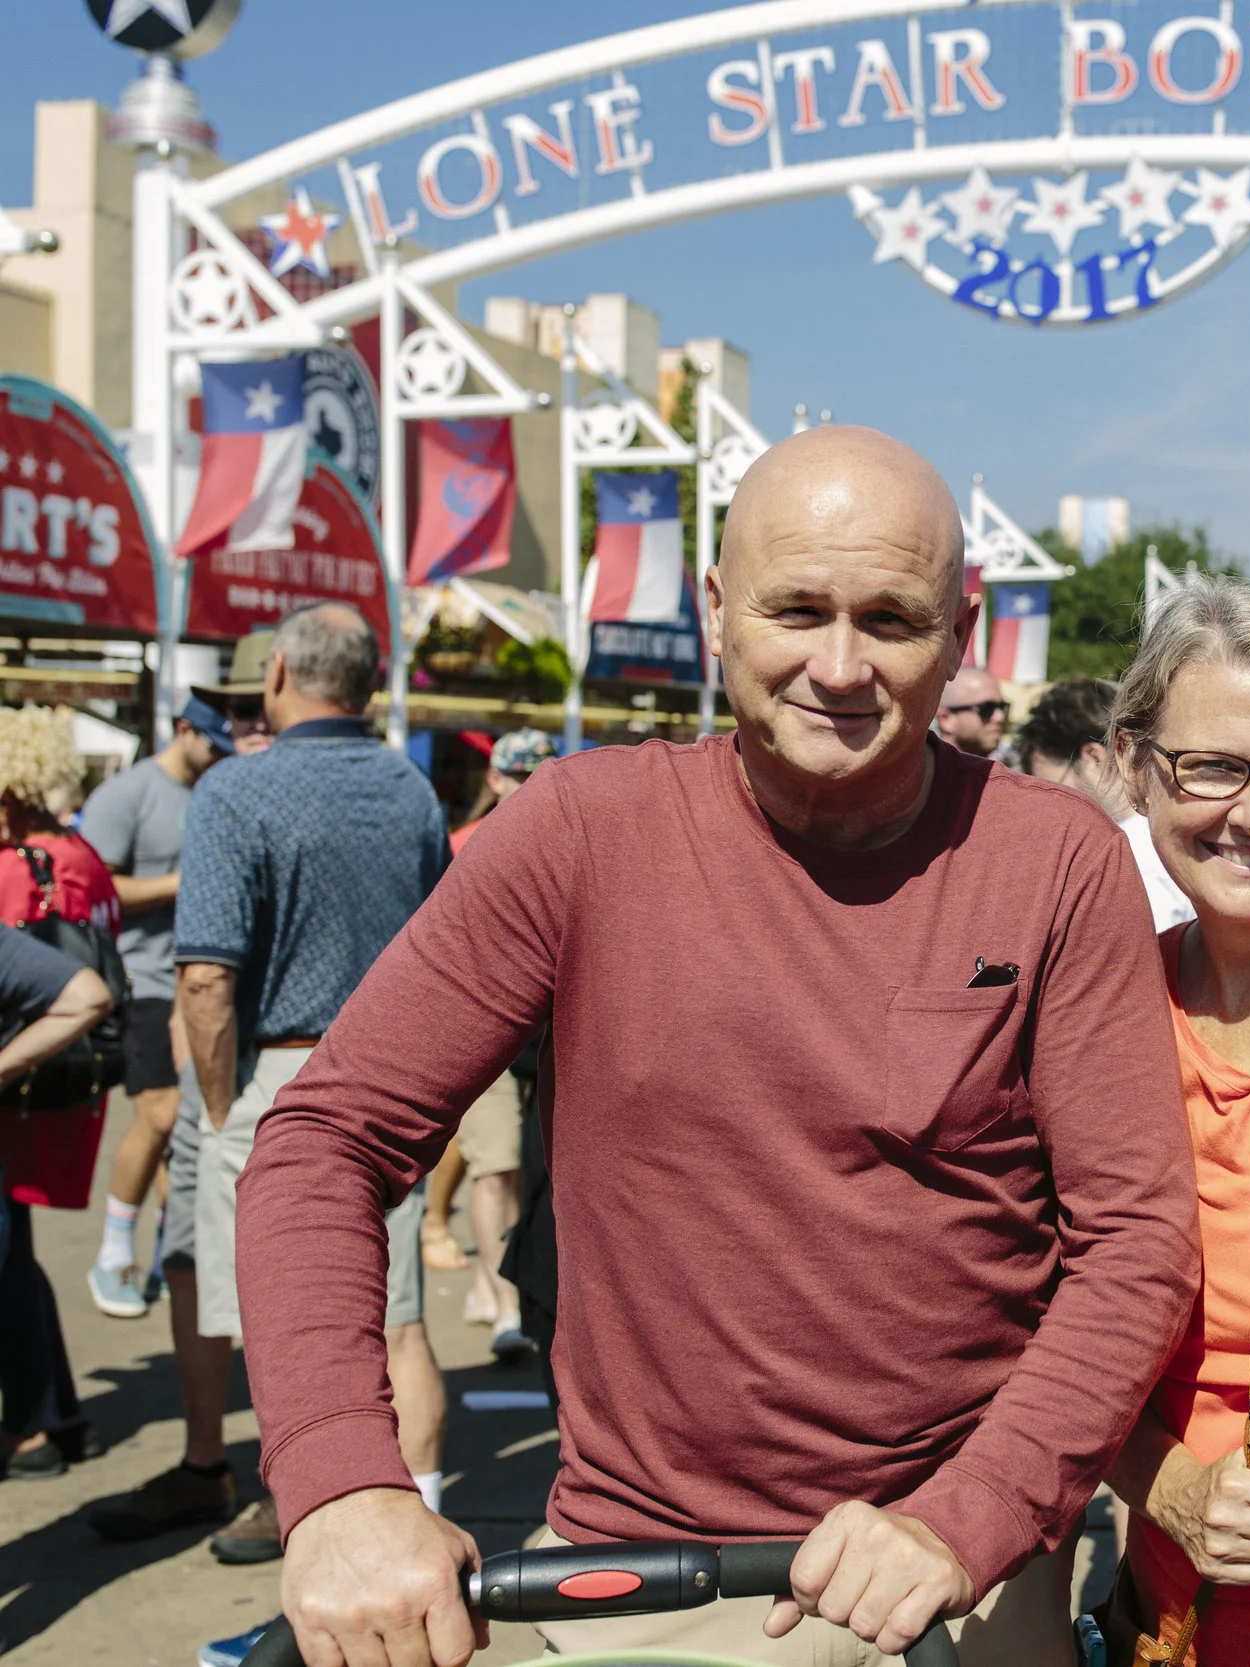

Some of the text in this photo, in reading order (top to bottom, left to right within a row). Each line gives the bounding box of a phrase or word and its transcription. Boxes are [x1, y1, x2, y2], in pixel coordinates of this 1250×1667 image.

[353, 84, 654, 243] LONE
[706, 28, 1007, 147] STAR
[952, 238, 1162, 328] 2017
